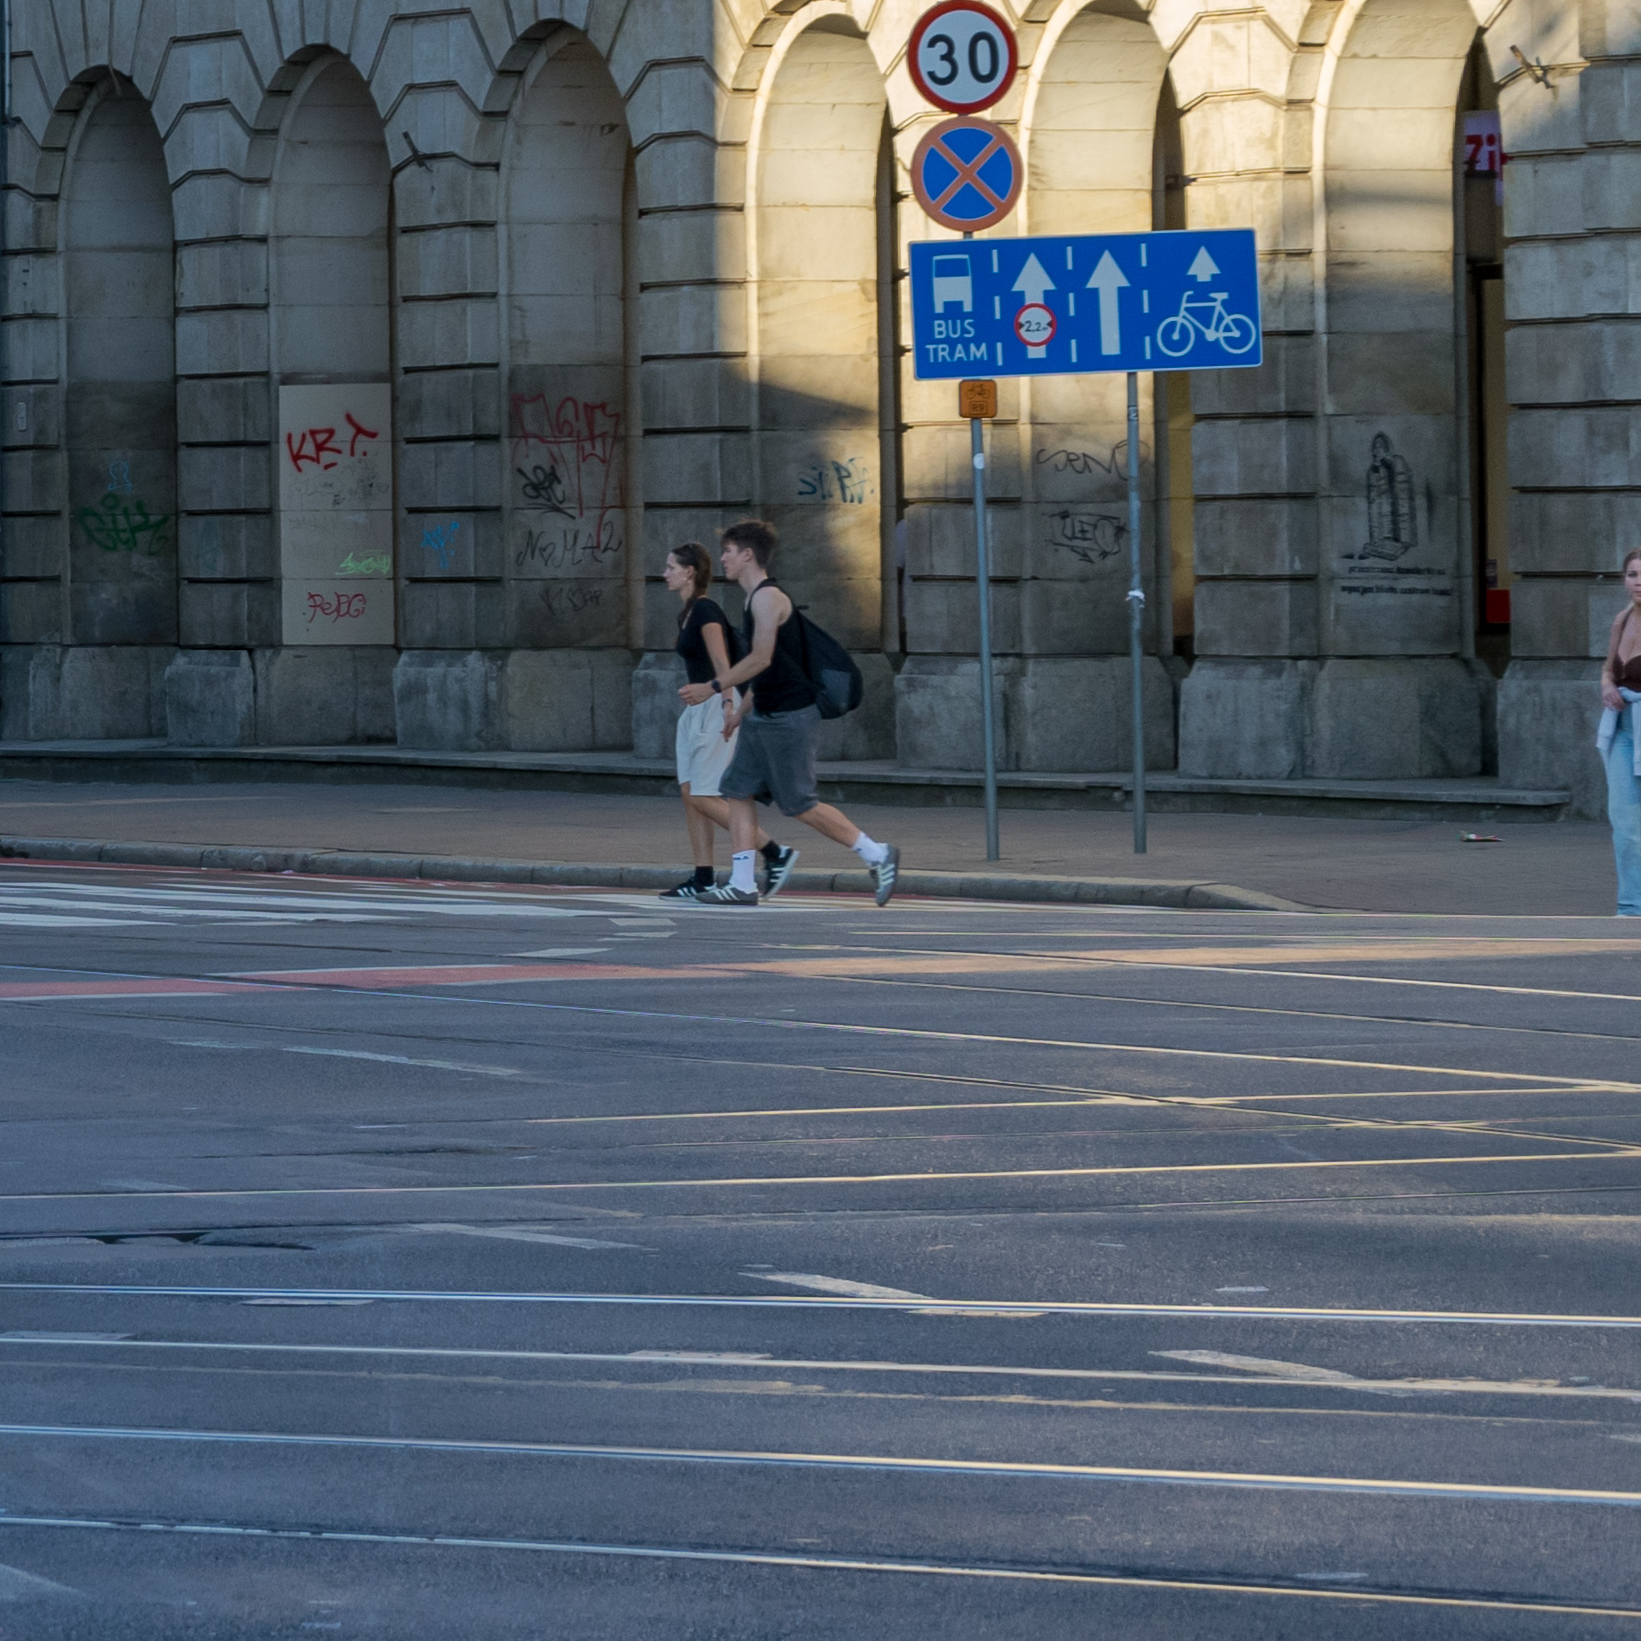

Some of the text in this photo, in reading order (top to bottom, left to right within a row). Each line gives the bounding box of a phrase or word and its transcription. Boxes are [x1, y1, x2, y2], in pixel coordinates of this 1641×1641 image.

[926, 31, 1000, 87] 30
[934, 319, 976, 339] BUS
[925, 342, 988, 363] TRAM
